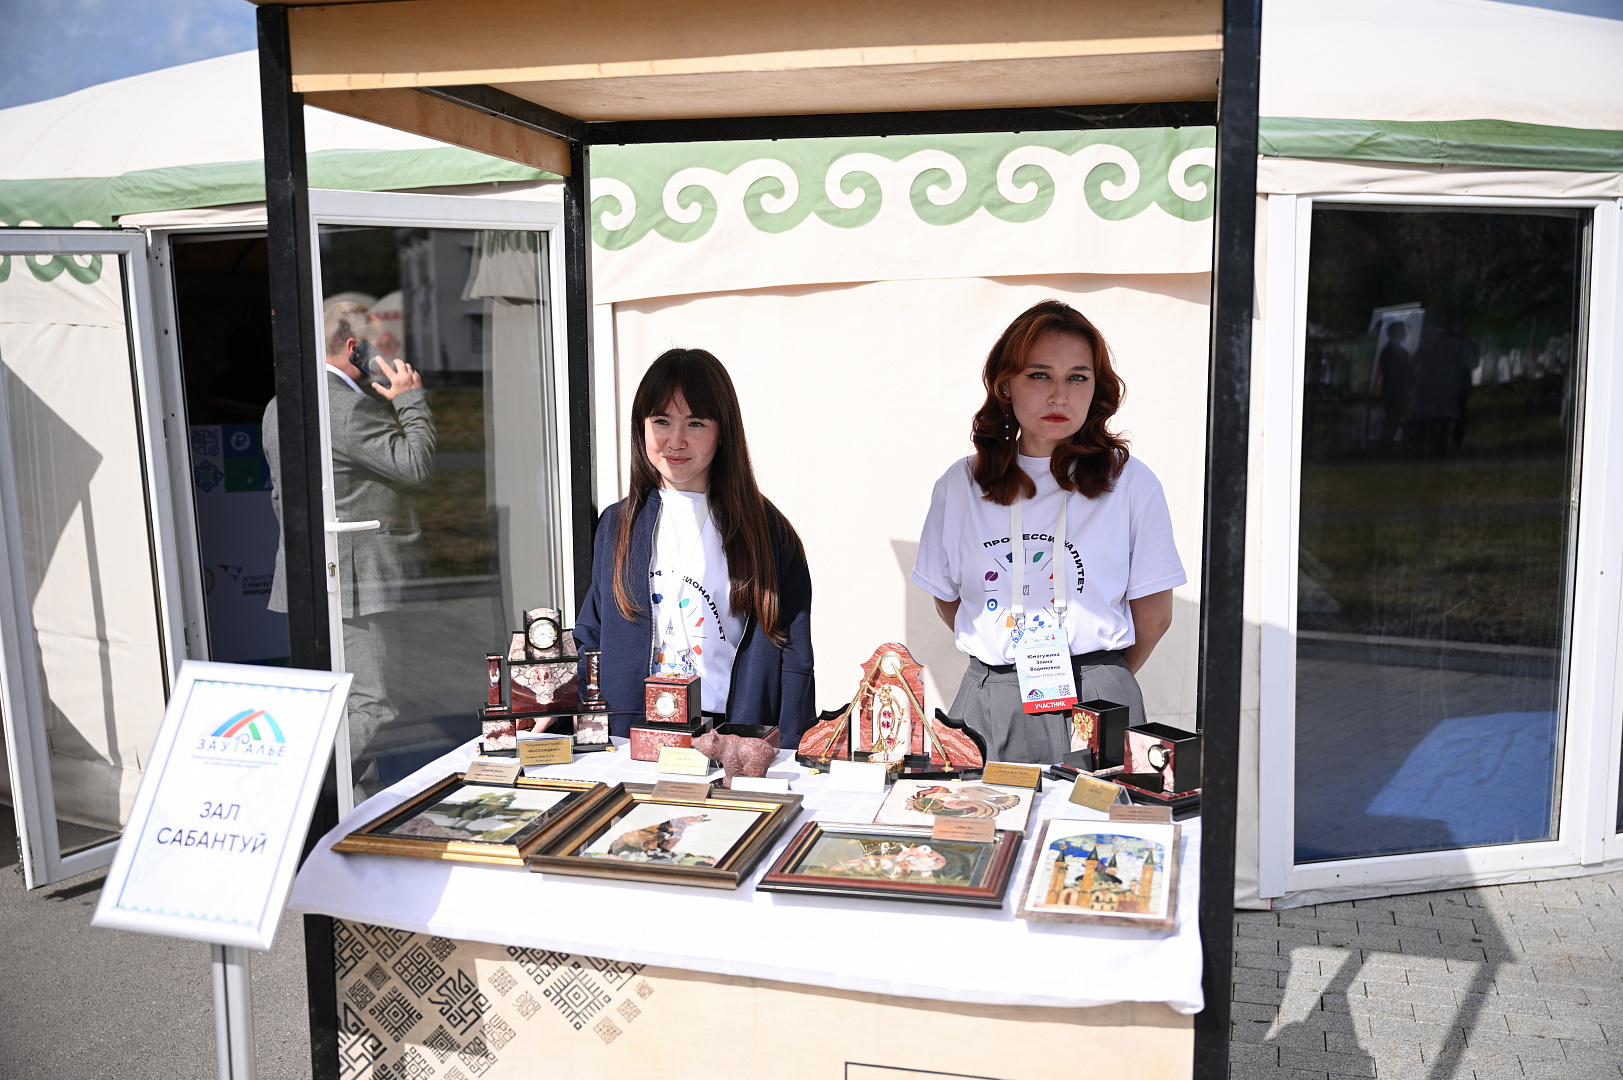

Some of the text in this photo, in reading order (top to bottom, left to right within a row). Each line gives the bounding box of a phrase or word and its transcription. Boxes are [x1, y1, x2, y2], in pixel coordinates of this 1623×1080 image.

[983, 533, 1084, 593] ПРОЕССИНАЛИТЕТ
[243, 581, 273, 589] СТРАТЕГ
[1034, 701, 1066, 710] УЧАСТНИК
[196, 733, 286, 757] ЗАУРАЛЬЕ
[199, 801, 241, 821] ЗАЛ
[156, 827, 268, 855] САБАНТУЙ
